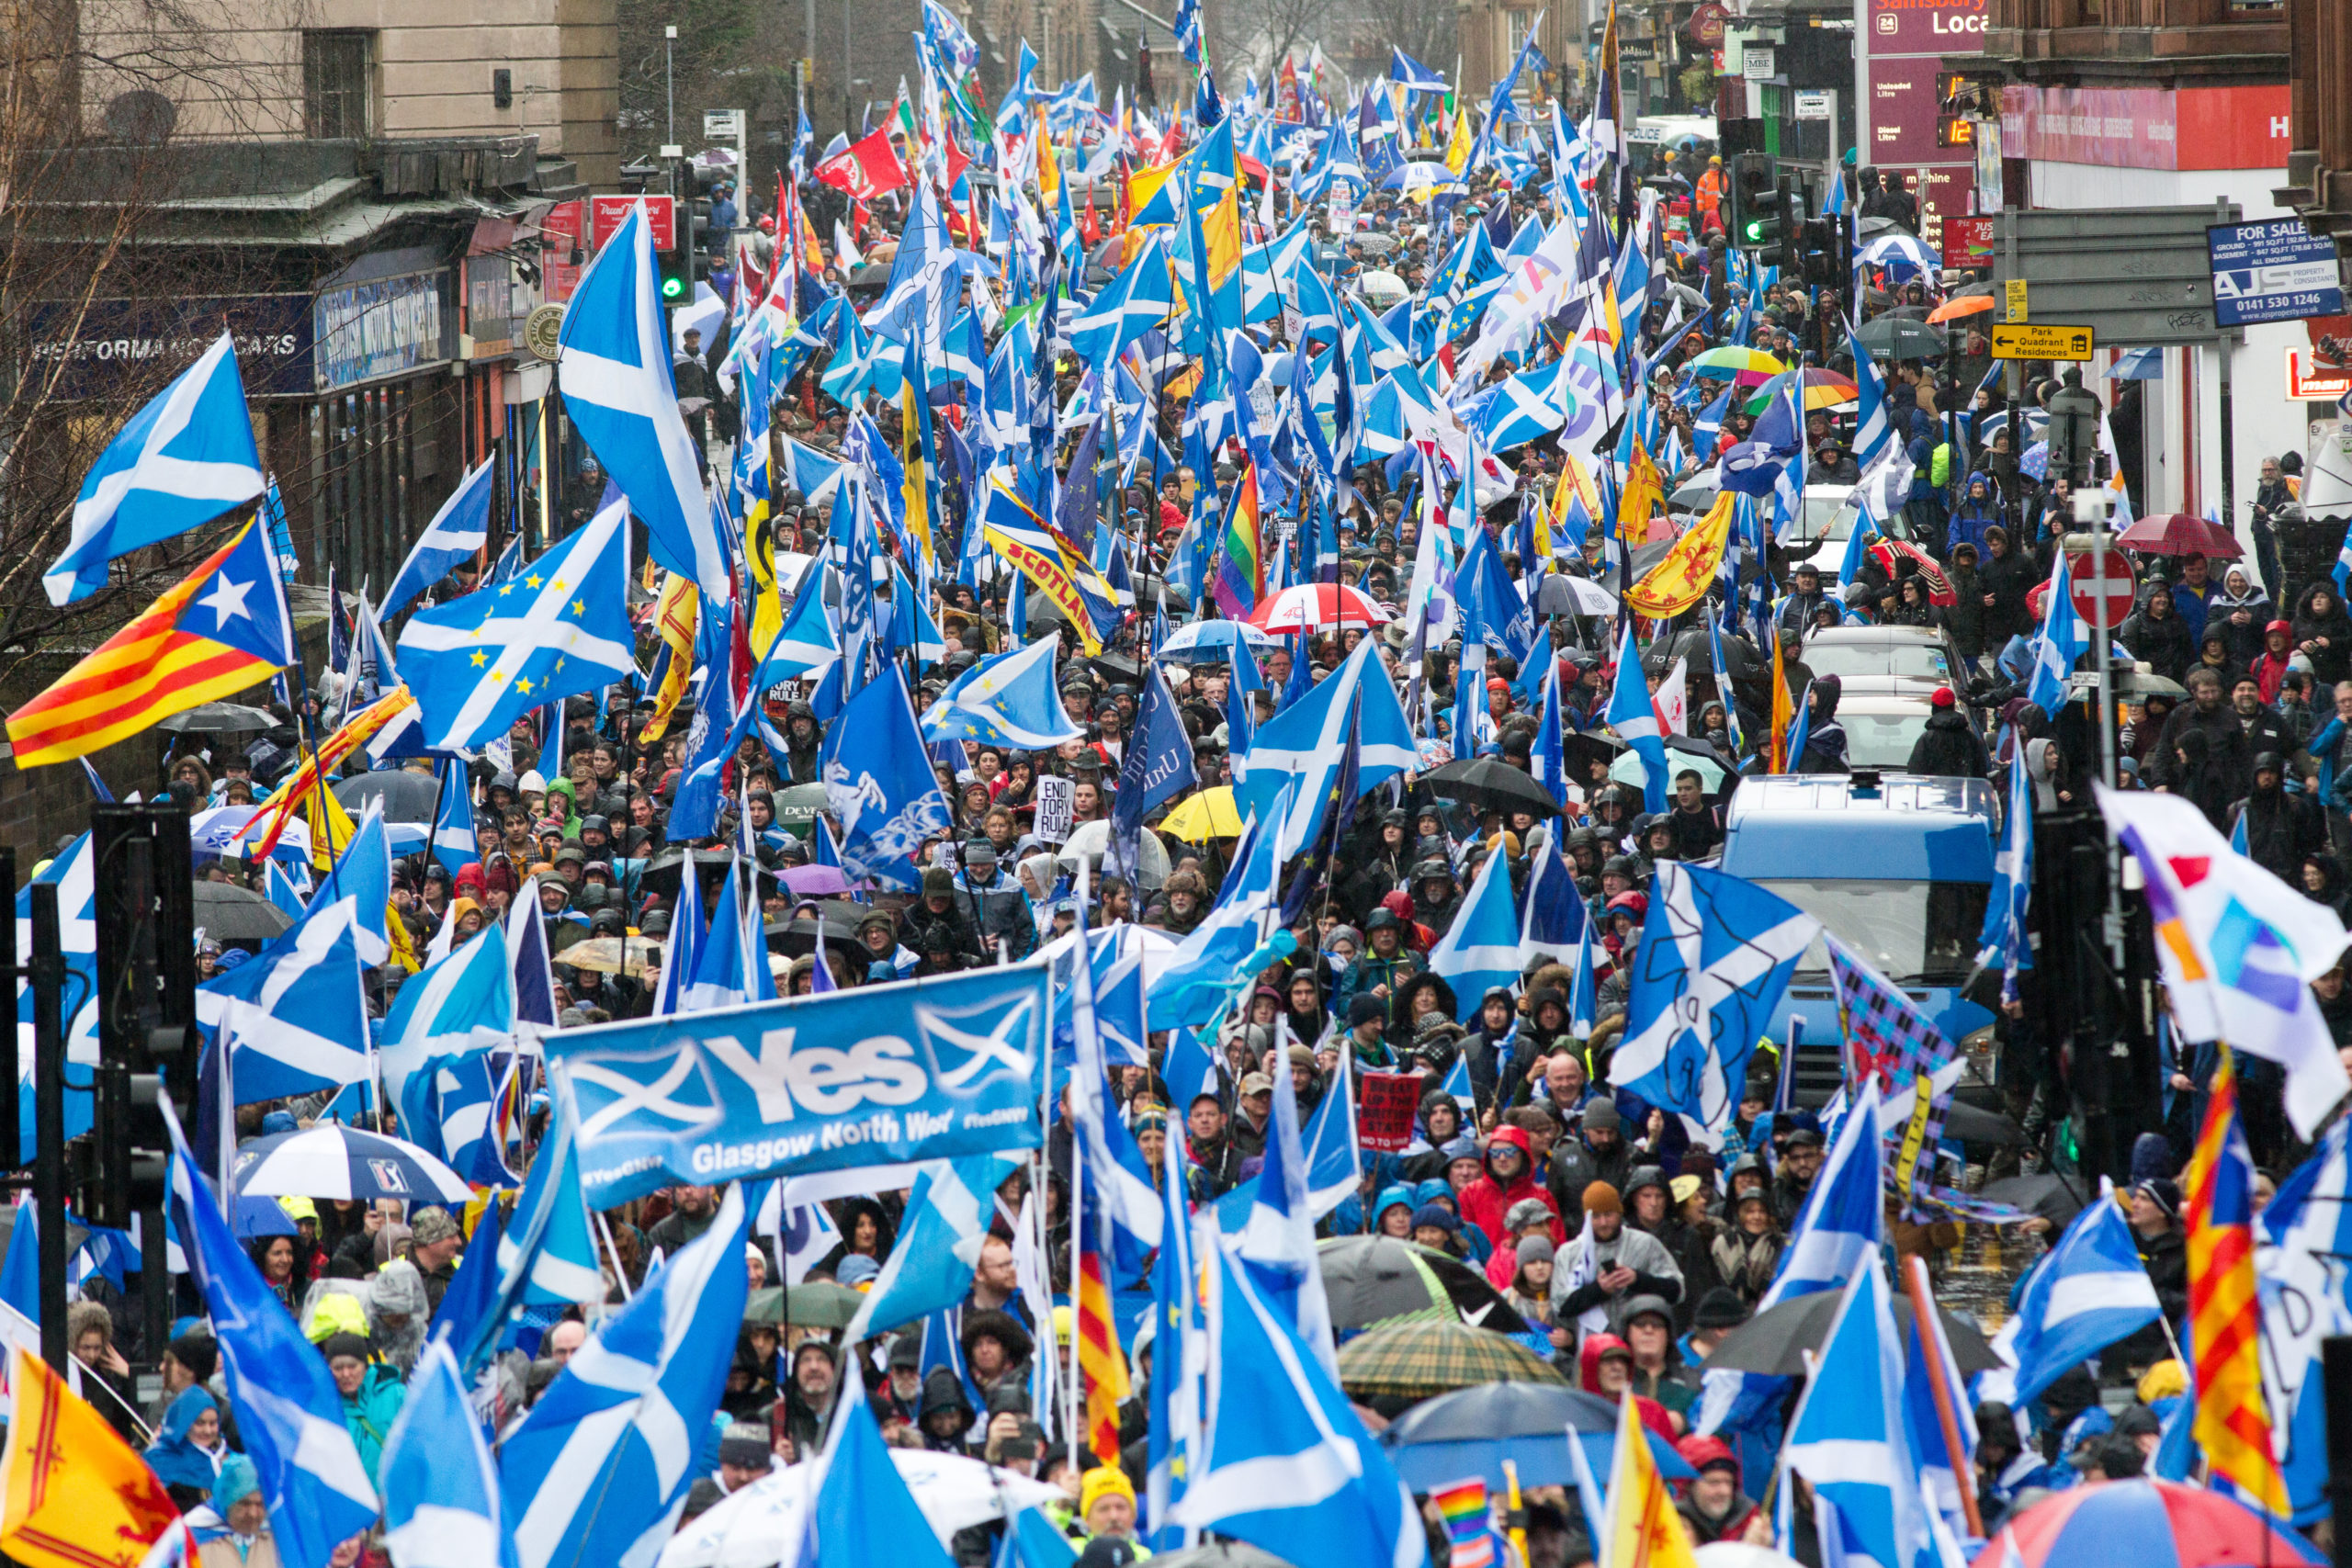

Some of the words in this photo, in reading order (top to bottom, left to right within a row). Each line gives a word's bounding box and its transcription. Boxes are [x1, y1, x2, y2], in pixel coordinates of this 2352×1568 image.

[1627, 128, 1660, 141] POLICE
[2236, 226, 2266, 242] FOR
[2270, 221, 2307, 238] SALE
[2216, 243, 2246, 252] GROUND
[2212, 251, 2248, 260] BASEMENT
[2265, 255, 2297, 265] ENQUIRIES
[2294, 267, 2325, 276] PROPERTY
[2214, 268, 2292, 298] AJS
[2294, 275, 2337, 285] CONSULTANTS
[2236, 299, 2264, 311] 0141
[2267, 297, 2290, 308] 530
[2293, 293, 2321, 305] 1246
[2241, 306, 2319, 320] www.ajsproperty.co.uk
[531, 311, 553, 334] ITALIAN
[232, 334, 297, 356] CARS
[2019, 337, 2064, 347] Quadrant
[2015, 347, 2068, 356] Residences
[769, 690, 800, 702] RULE
[1045, 782, 1067, 798] END
[1041, 798, 1069, 817] TORY
[1041, 816, 1069, 833] RULE
[703, 1026, 928, 1125] Yes
[692, 1133, 816, 1174] Glasgow
[821, 1112, 900, 1151] North
[1361, 1135, 1375, 1145] NO
[1377, 1137, 1391, 1146] TO
